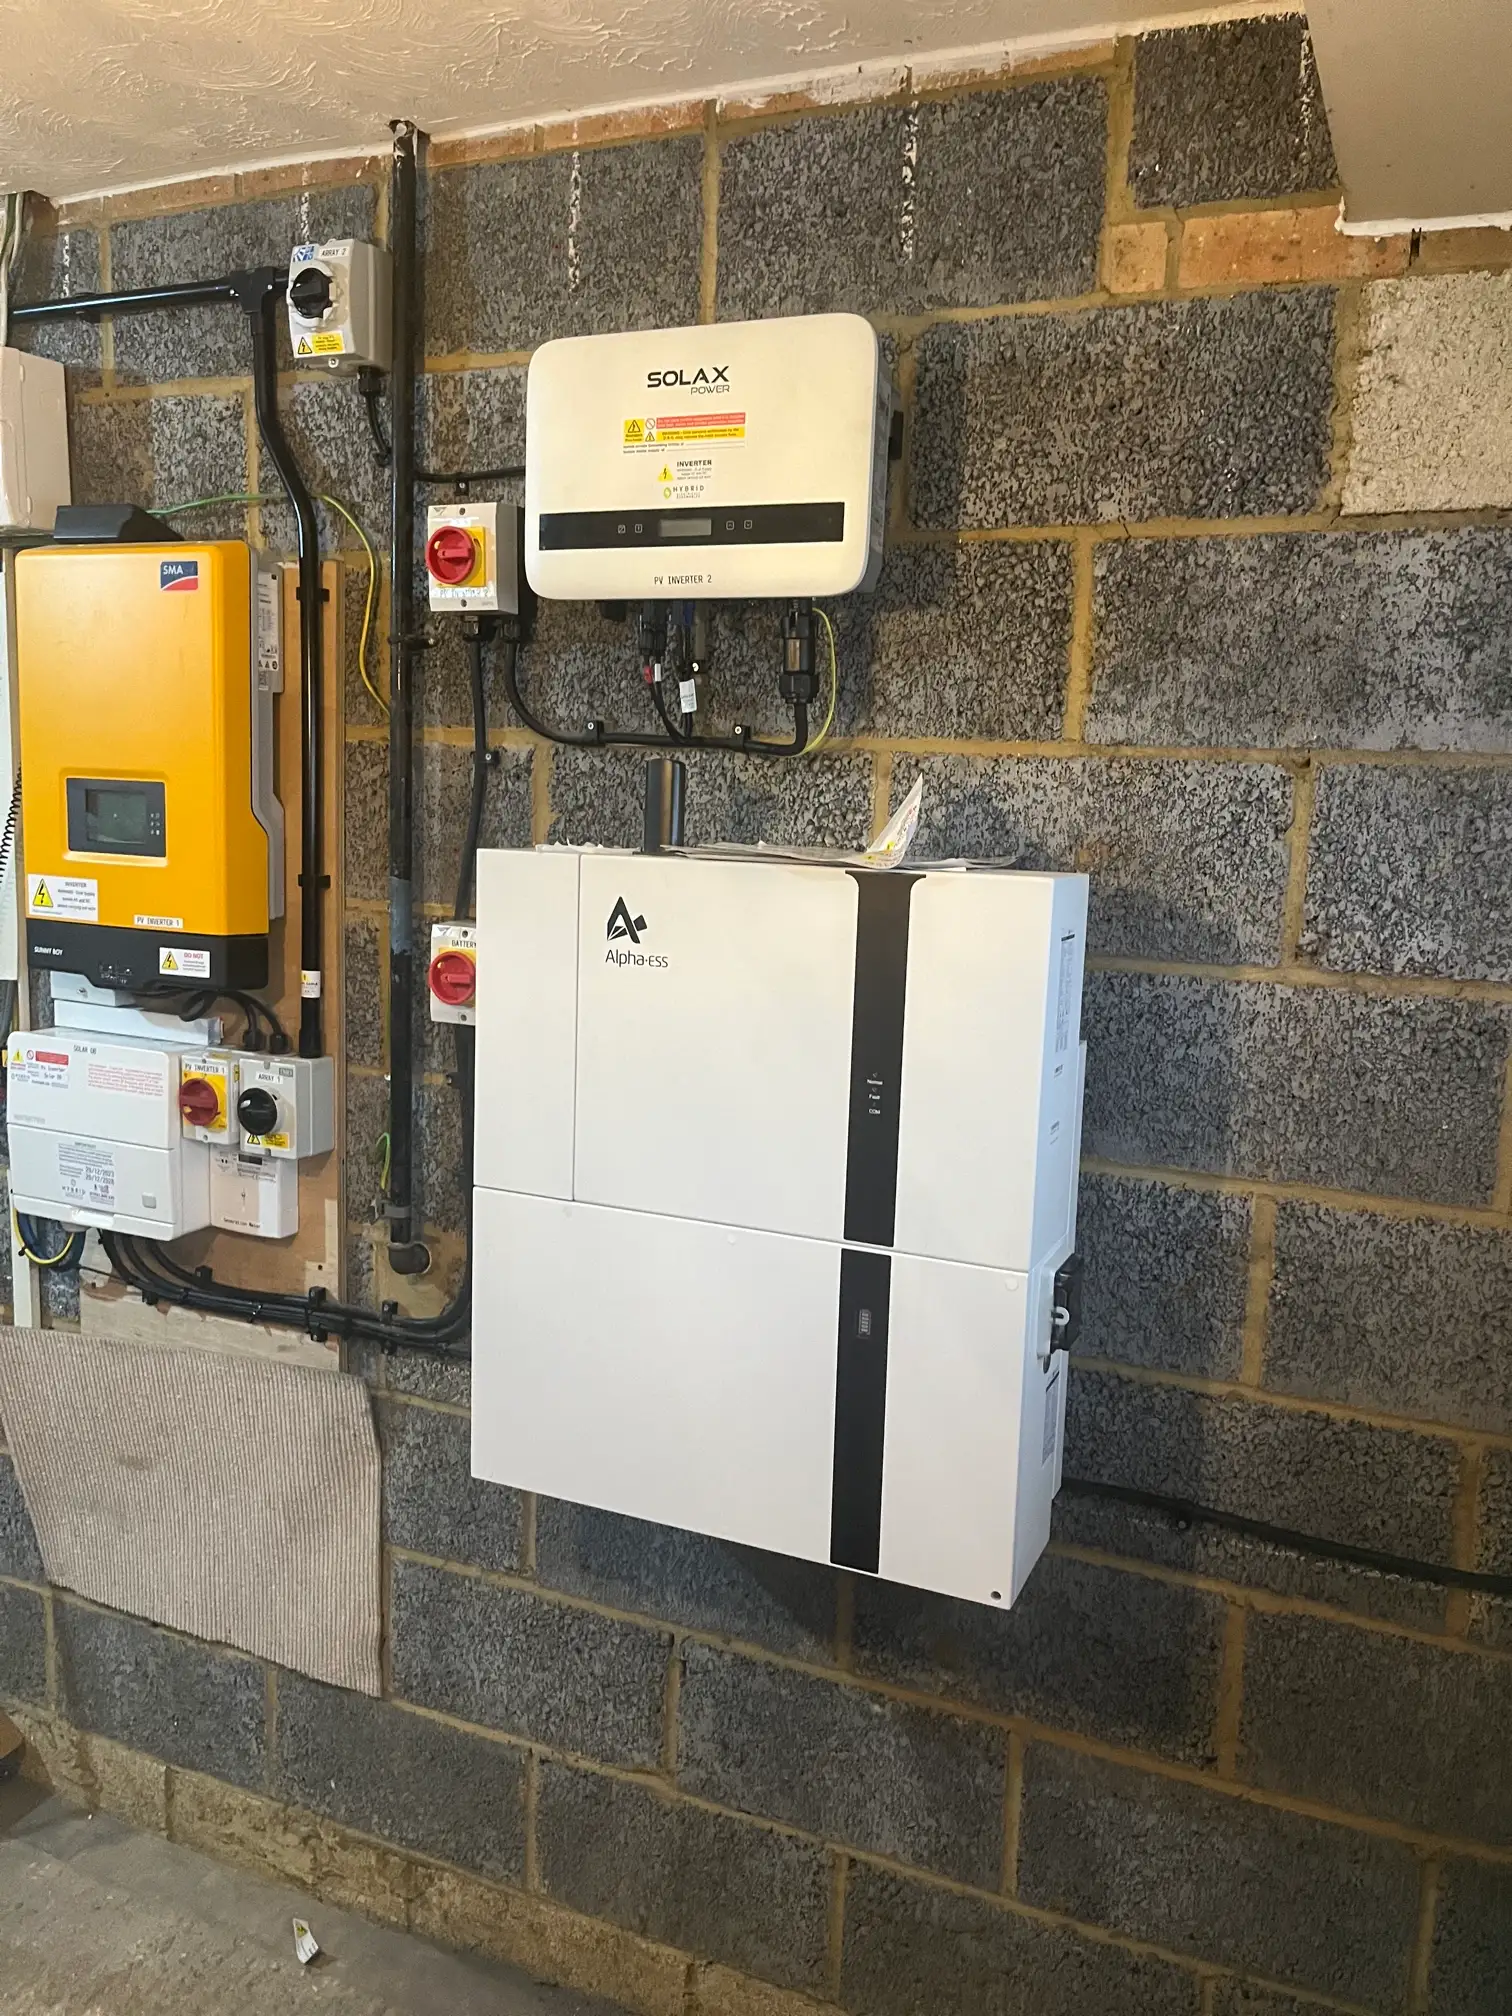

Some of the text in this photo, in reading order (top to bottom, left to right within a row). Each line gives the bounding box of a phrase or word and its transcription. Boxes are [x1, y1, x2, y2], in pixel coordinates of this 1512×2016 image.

[321, 247, 347, 257] ARRAY 2
[647, 365, 730, 388] SOLAX
[690, 384, 731, 395] POWER
[676, 459, 713, 468] INVERTER
[162, 564, 184, 575] SMA
[653, 574, 713, 585] PV INVERTER 2
[136, 916, 145, 924] PV
[147, 917, 174, 927] INVERTER
[73, 1044, 89, 1053] SOLAR
[194, 1063, 219, 1074] INVERTER
[258, 1073, 275, 1082] ARRAY
